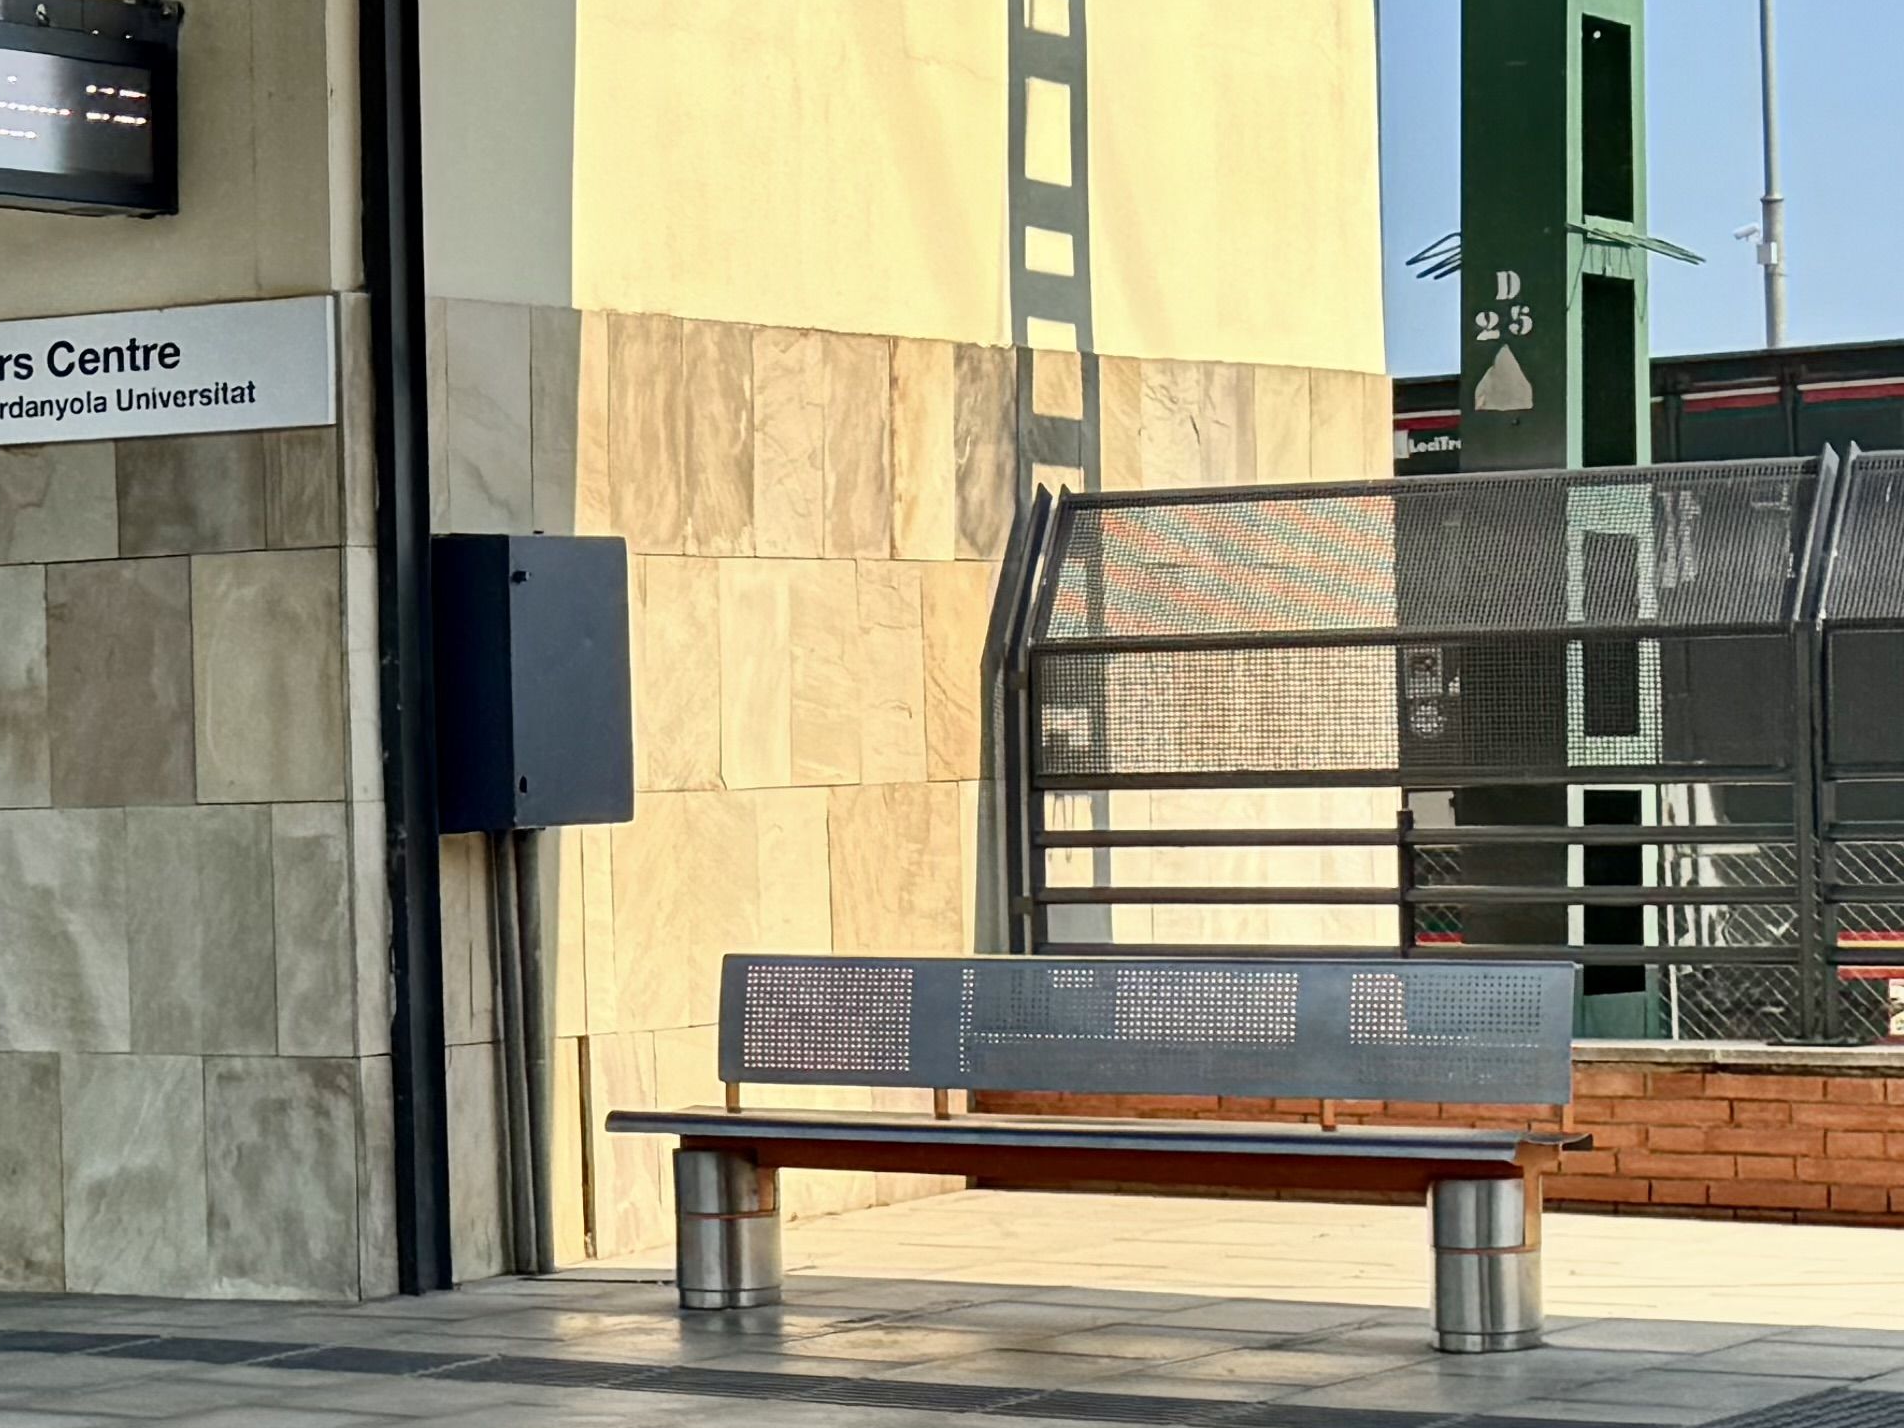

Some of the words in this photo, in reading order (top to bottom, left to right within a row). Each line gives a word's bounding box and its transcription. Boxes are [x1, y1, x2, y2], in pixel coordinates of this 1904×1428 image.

[1496, 270, 1521, 301] D
[1475, 305, 1533, 341] 25
[46, 336, 182, 377] Centre
[116, 379, 257, 413] Universitat
